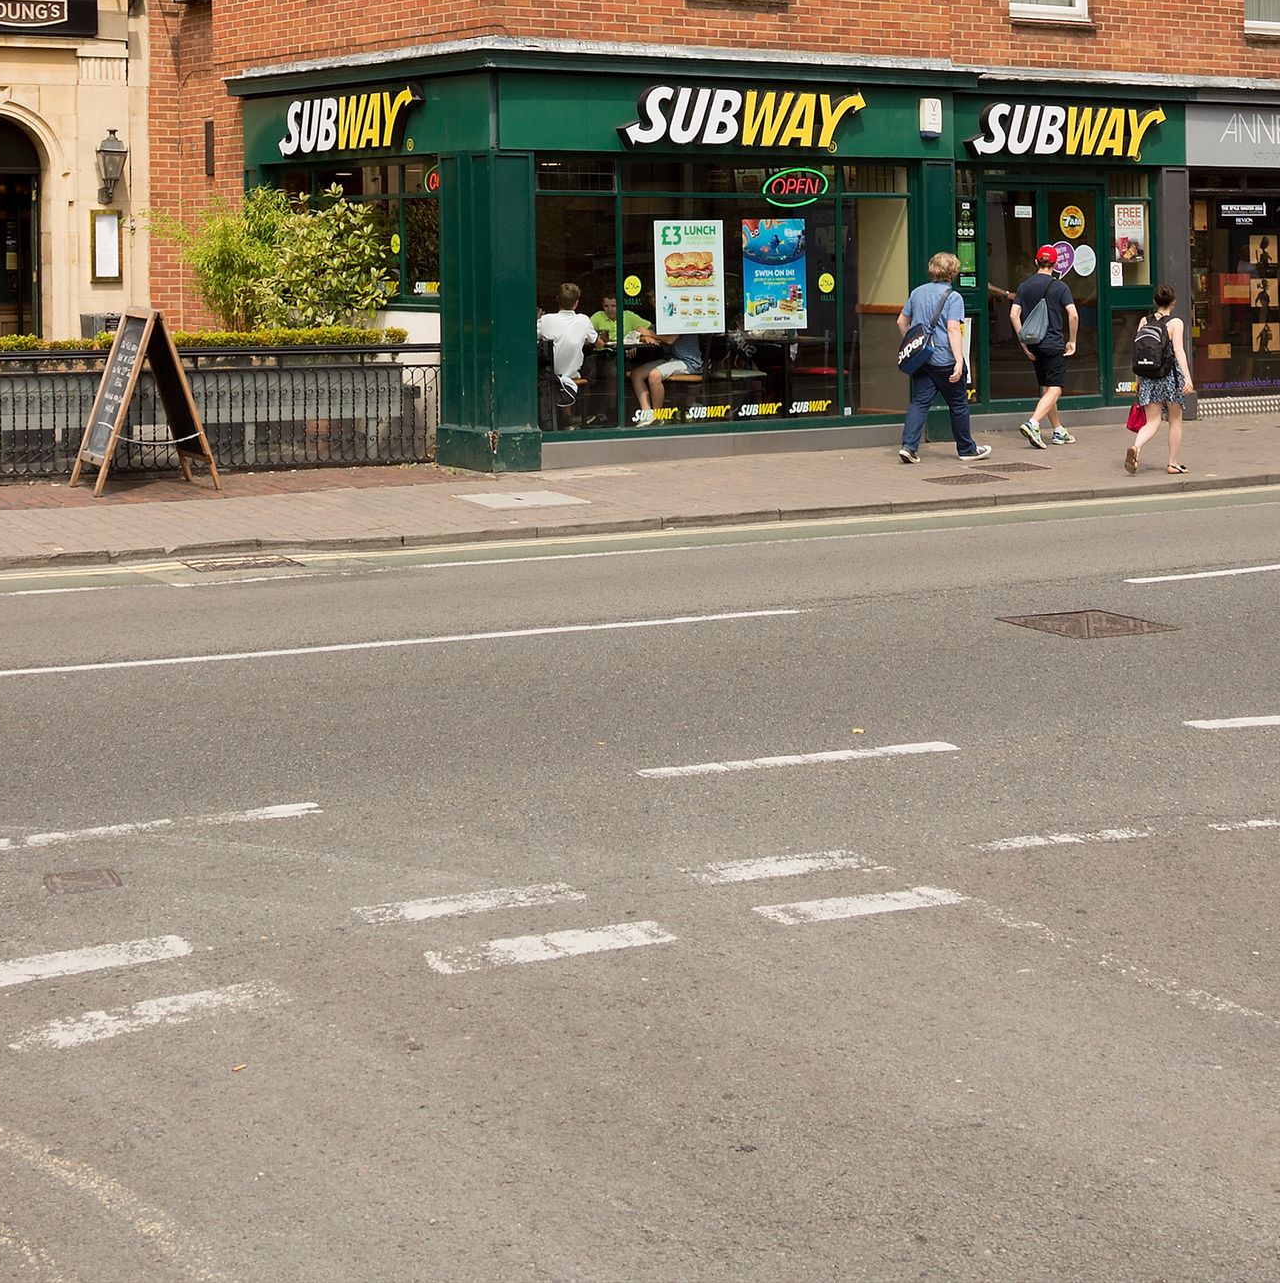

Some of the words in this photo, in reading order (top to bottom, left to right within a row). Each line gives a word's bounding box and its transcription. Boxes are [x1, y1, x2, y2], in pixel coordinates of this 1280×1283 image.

[278, 86, 413, 156] SUBWAY
[625, 85, 867, 148] SUBWAY
[972, 103, 1167, 156] SUBWAY
[1117, 207, 1141, 217] FREE
[1117, 218, 1142, 227] Cookie
[661, 225, 682, 246] £3
[684, 225, 716, 235] LUNCH
[754, 269, 773, 277] SWIM
[1116, 381, 1137, 393] SUB
[685, 405, 731, 419] SUBWAY
[738, 402, 782, 416] SUBWAY
[789, 399, 832, 414] SUBWAY
[632, 407, 678, 422] SUBWAY
